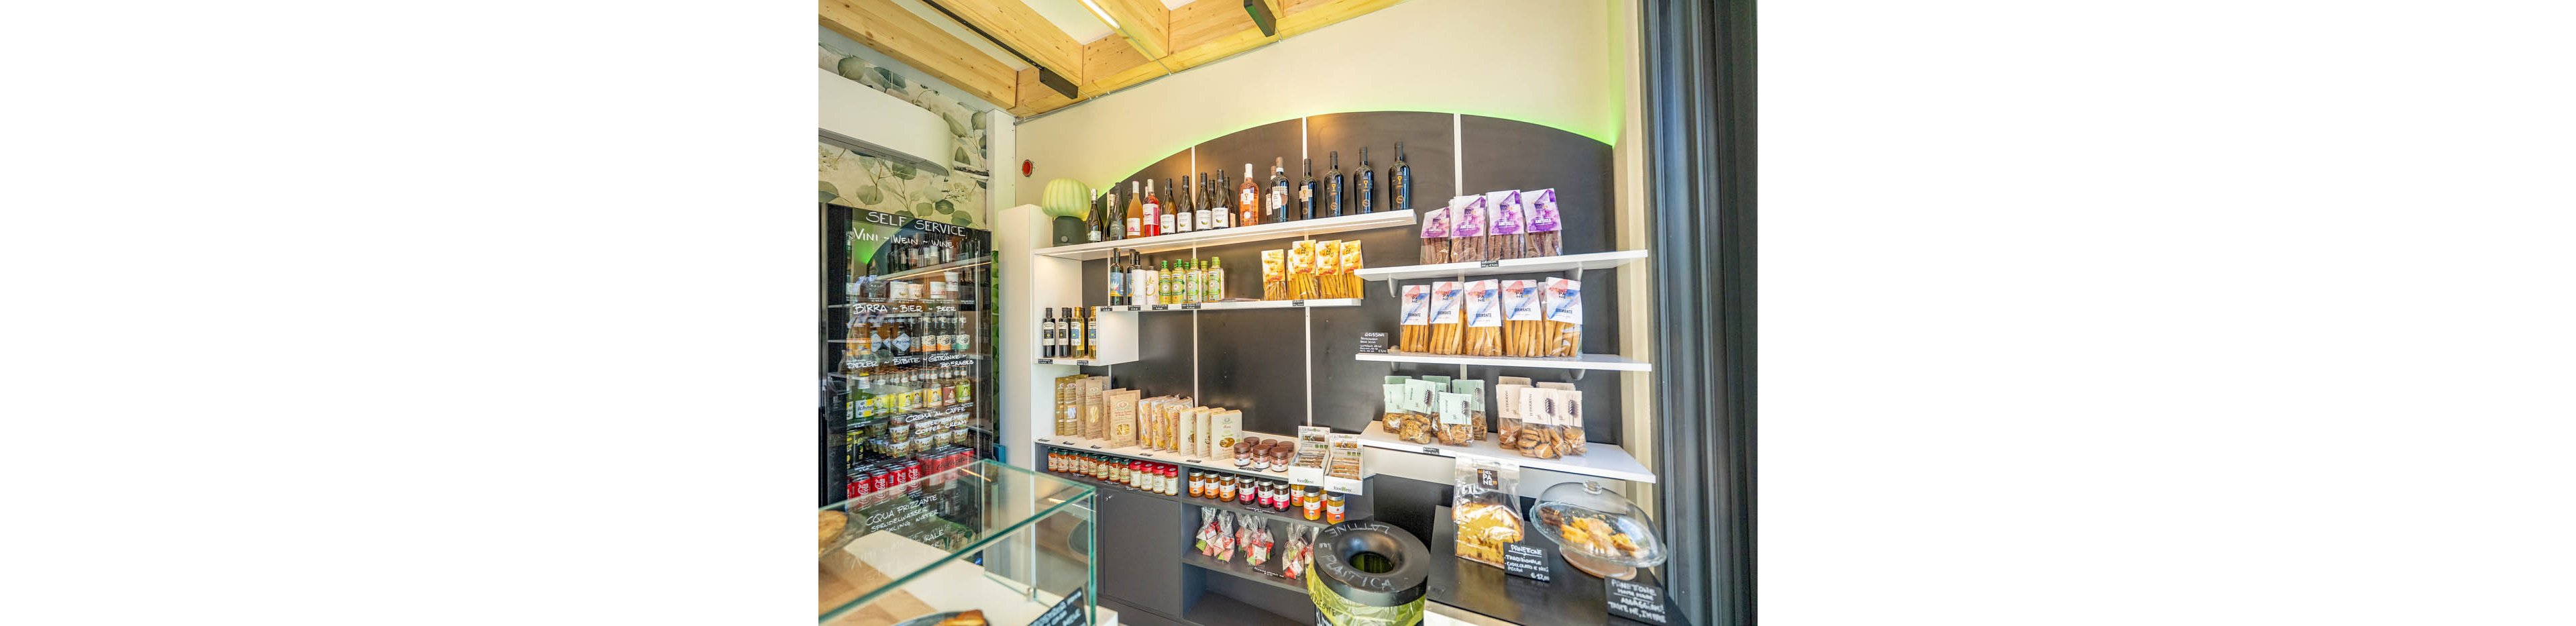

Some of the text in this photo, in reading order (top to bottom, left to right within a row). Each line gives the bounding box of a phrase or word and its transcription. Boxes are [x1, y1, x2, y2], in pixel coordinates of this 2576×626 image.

[865, 211, 966, 237] SELF SERVICE
[931, 240, 954, 248] WINE
[853, 304, 888, 314] BIRRA
[900, 305, 923, 313] BIER
[893, 357, 921, 366] BIBITE
[906, 413, 932, 423] CREMA
[915, 425, 941, 434] COFFEE
[945, 420, 967, 429] CREAM
[896, 494, 937, 514] FRIZZANTE
[1511, 544, 1542, 555] PANETTONE
